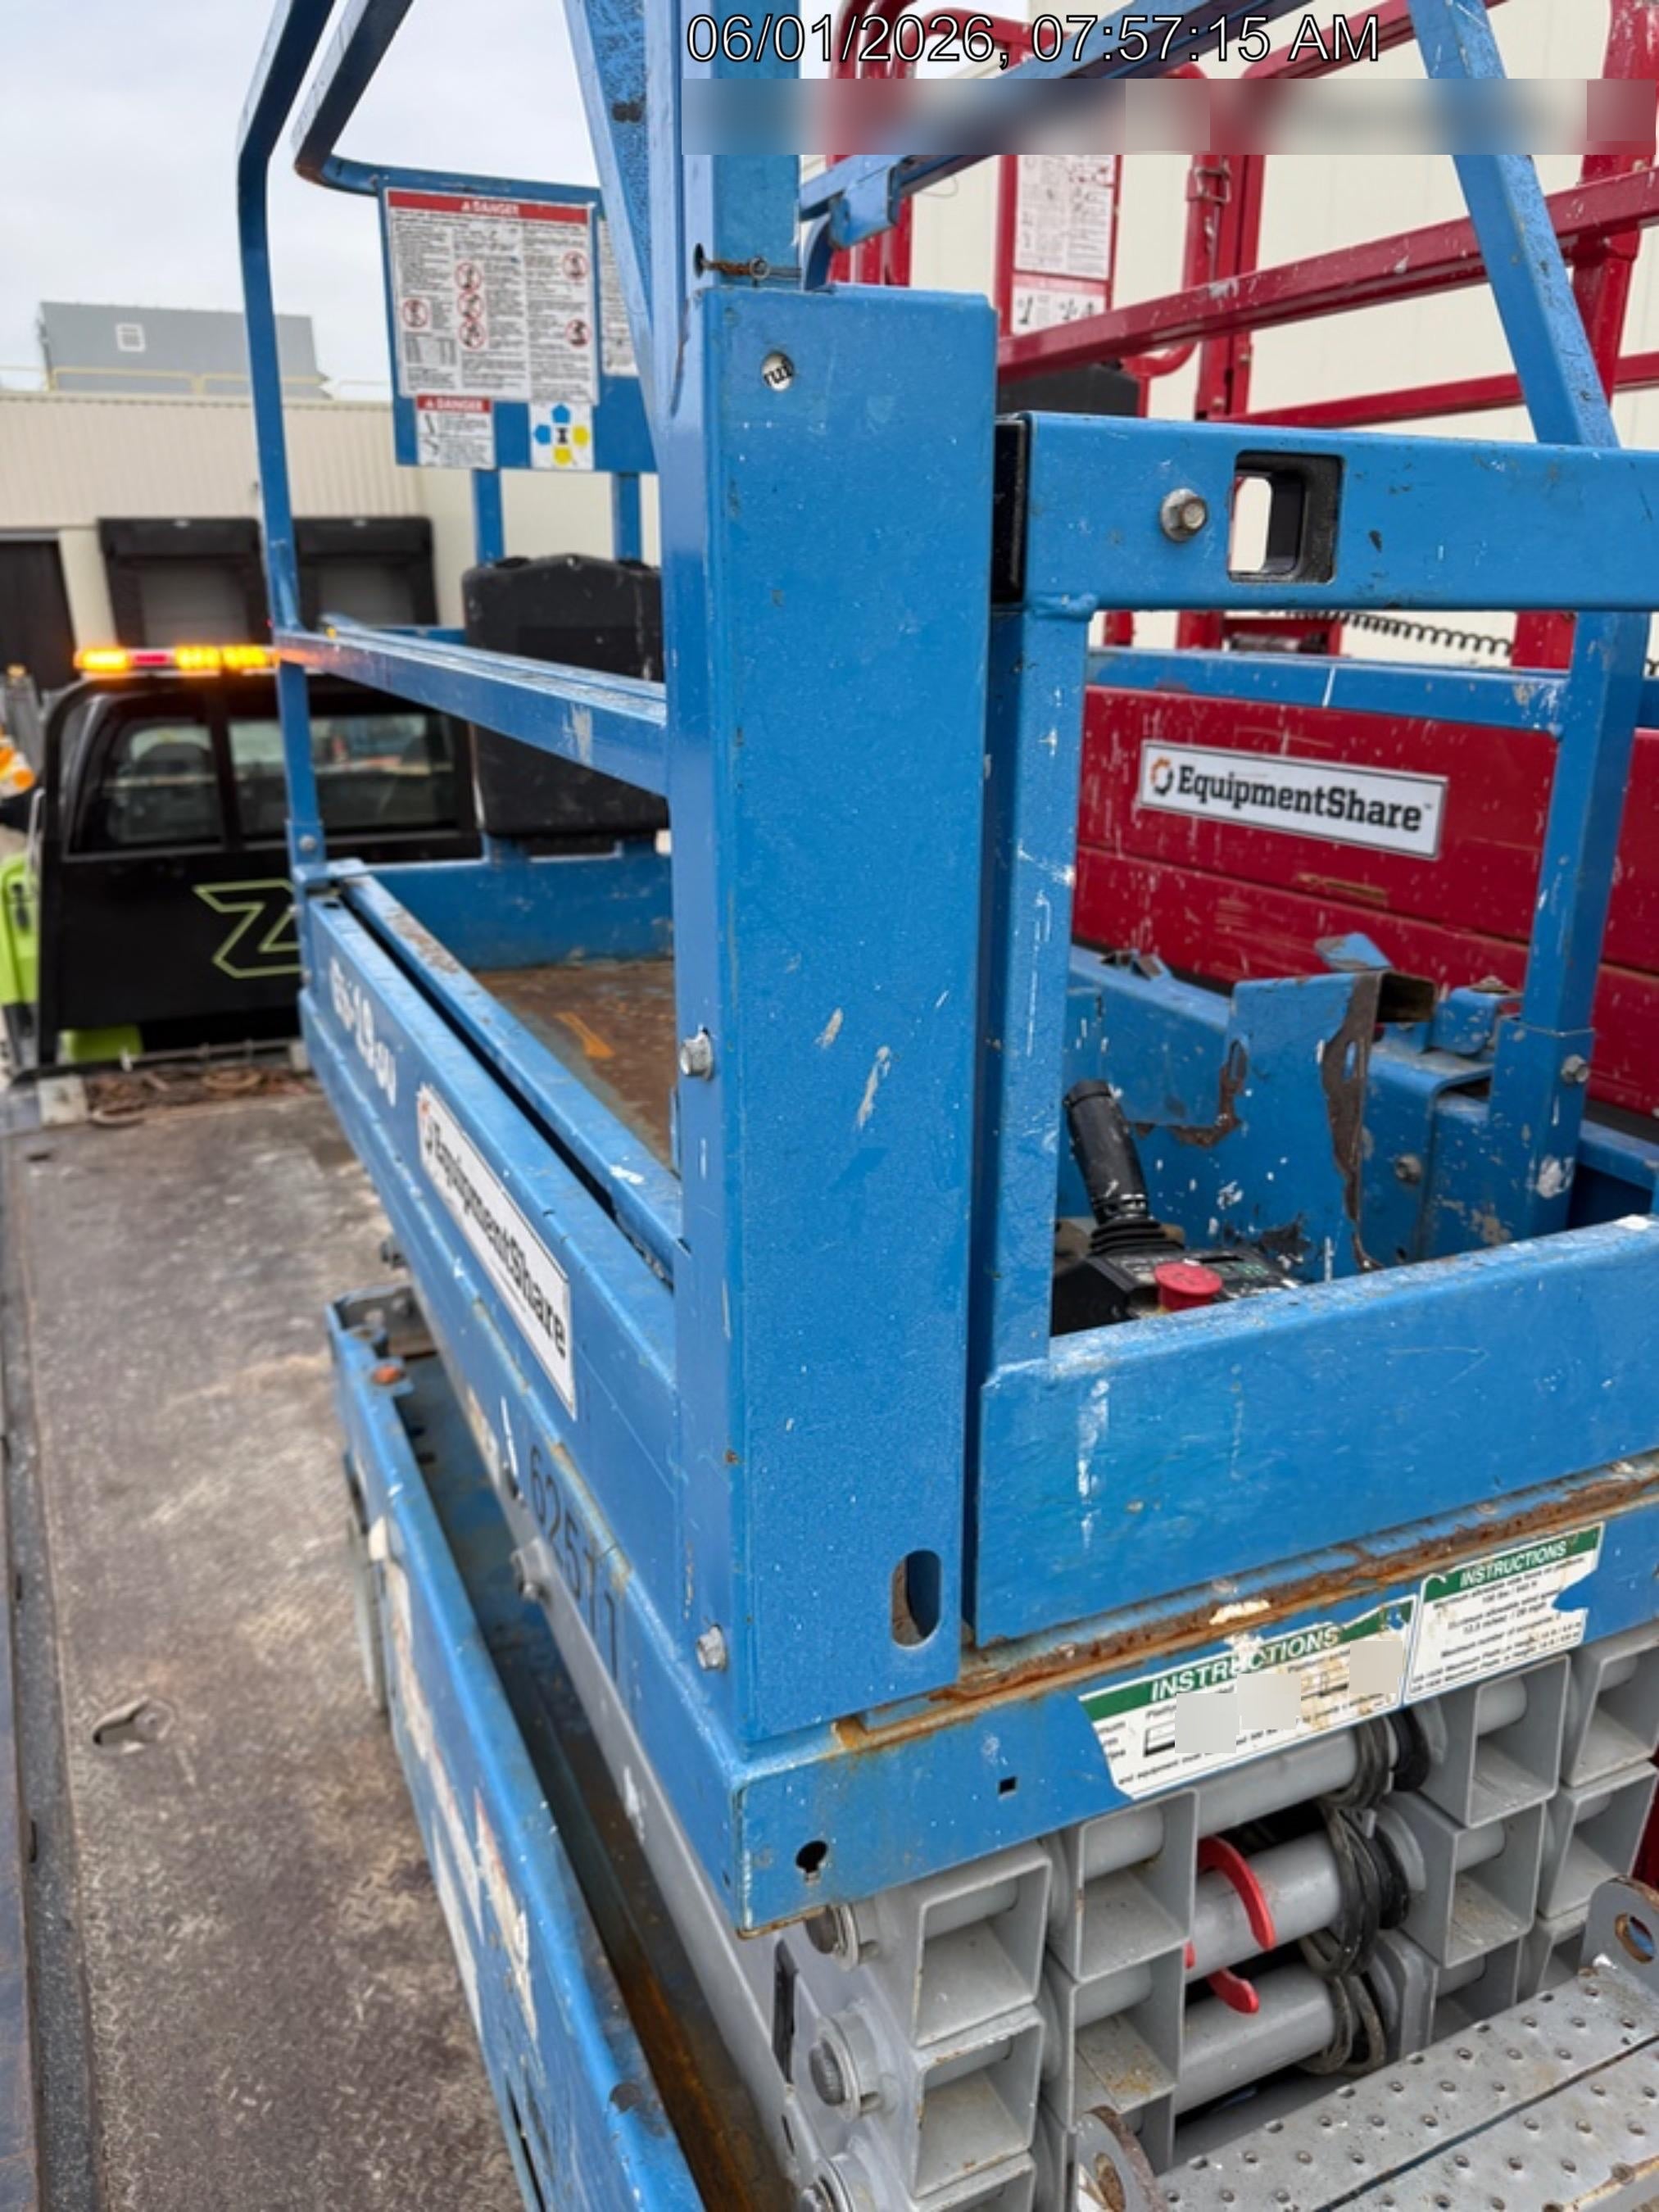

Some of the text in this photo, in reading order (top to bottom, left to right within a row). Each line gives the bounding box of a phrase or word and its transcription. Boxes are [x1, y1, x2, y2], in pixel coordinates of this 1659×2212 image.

[1177, 764, 1422, 832] EquipmentShare
[432, 1120, 566, 1359] EquipmentShare
[1460, 1539, 1567, 1589] INSTRUCTIONS
[1151, 1625, 1339, 1702] INSTRCTIONS
